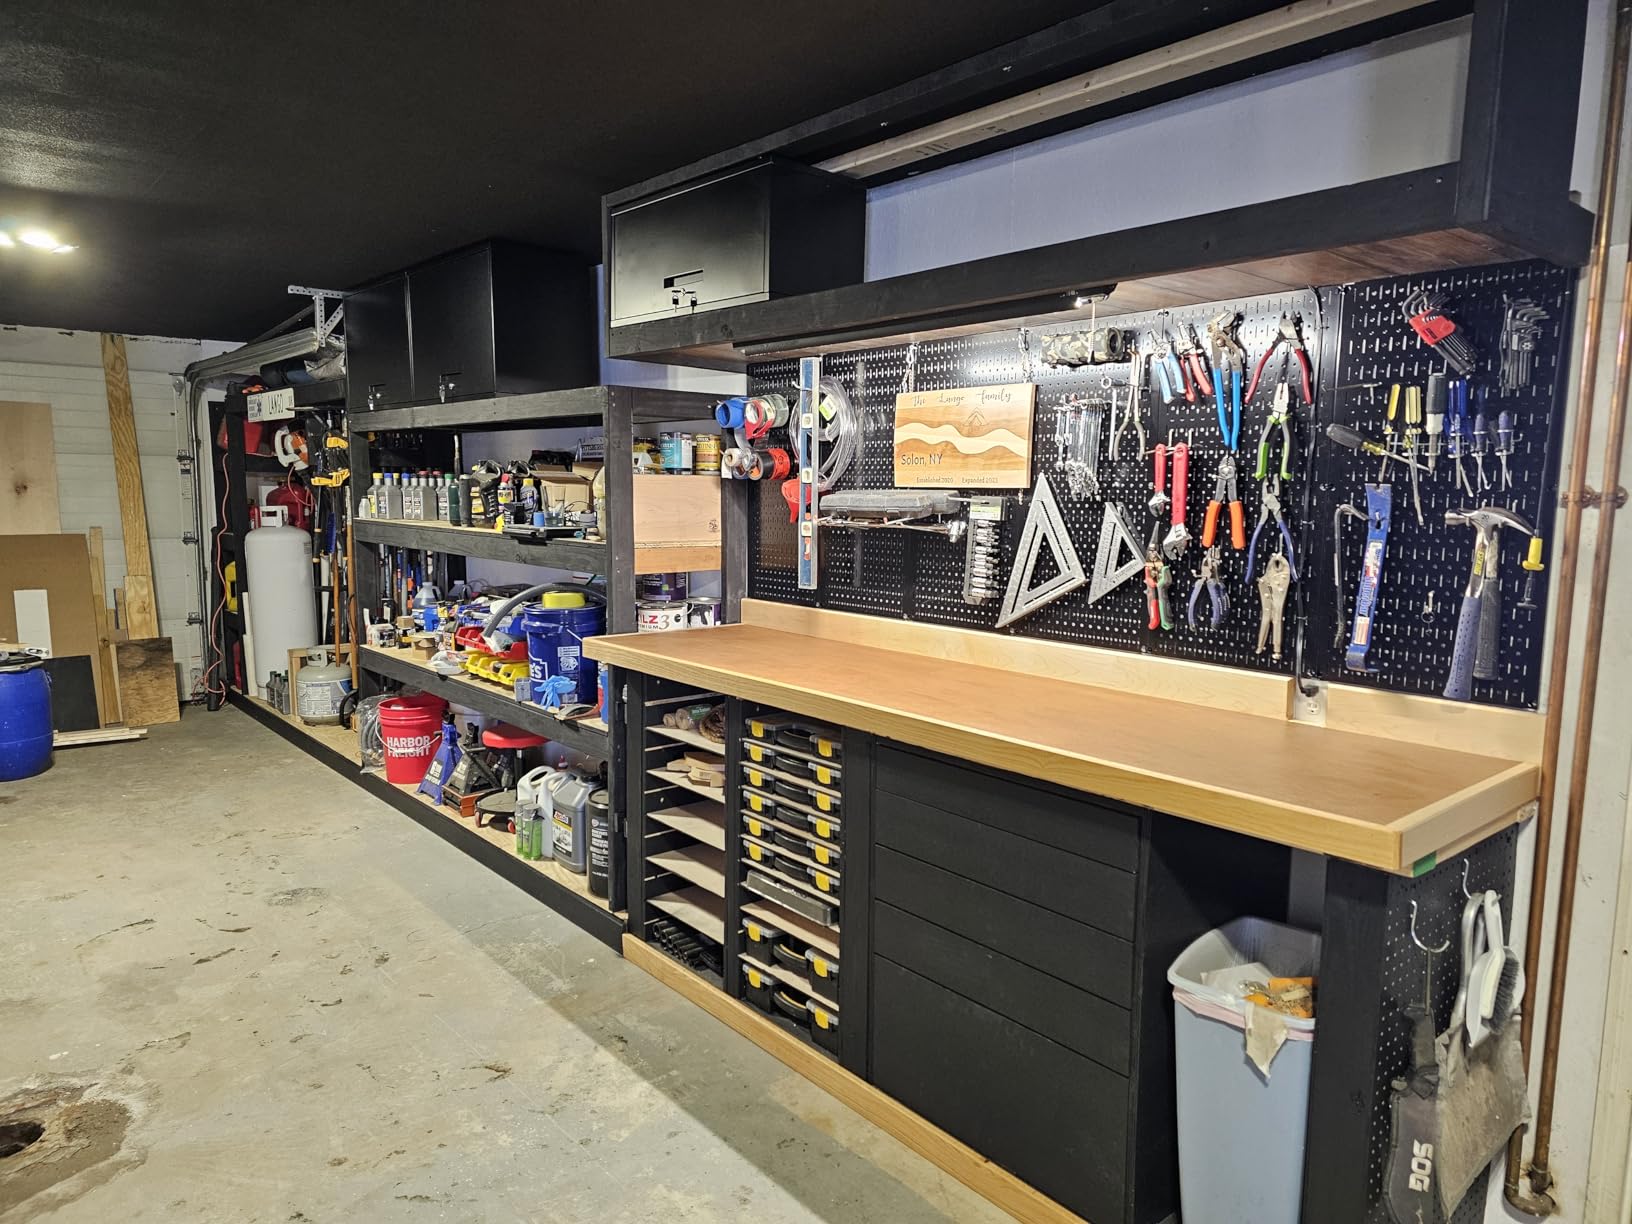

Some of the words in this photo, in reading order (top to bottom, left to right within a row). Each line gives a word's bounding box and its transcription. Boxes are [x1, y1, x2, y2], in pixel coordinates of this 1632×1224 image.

[911, 395, 926, 407] The
[901, 454, 927, 467] Solon,
[929, 453, 943, 465] NY
[916, 476, 941, 484] Established
[961, 476, 985, 485] Expanded
[658, 614, 671, 630] 3
[386, 735, 431, 748] HARBOR
[387, 745, 431, 758] FREIGHT
[1408, 1139, 1434, 1193] SOG
